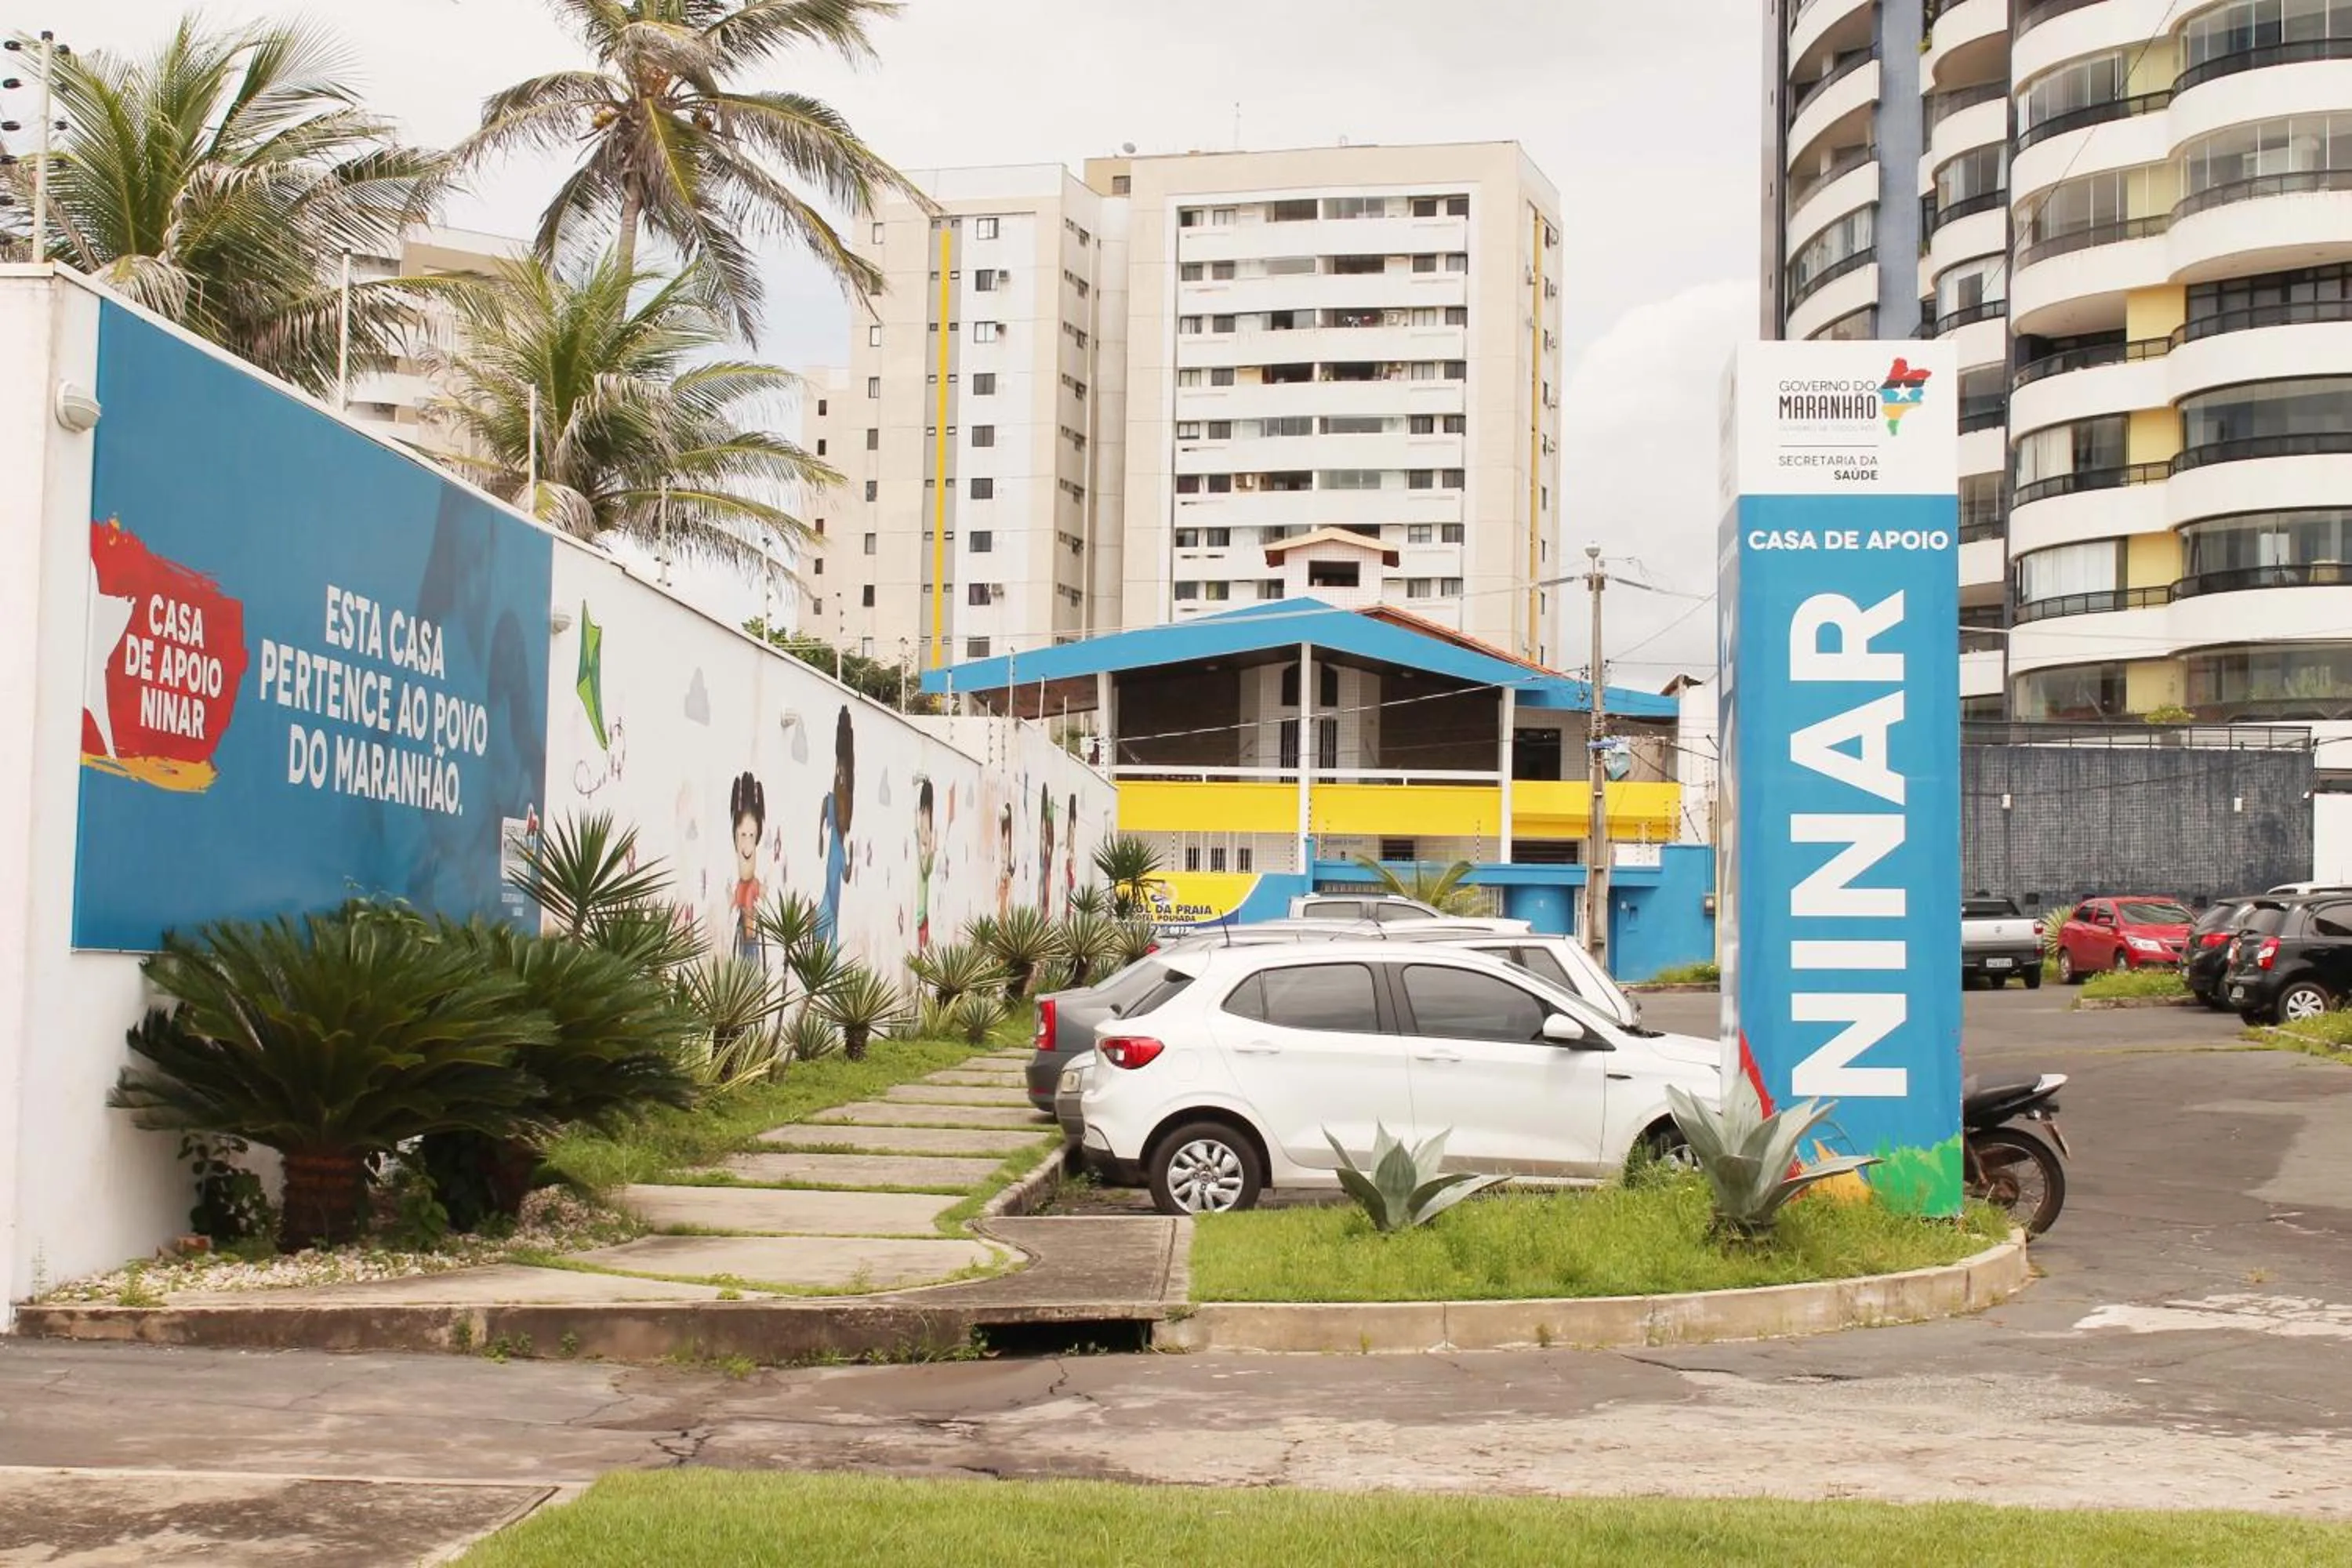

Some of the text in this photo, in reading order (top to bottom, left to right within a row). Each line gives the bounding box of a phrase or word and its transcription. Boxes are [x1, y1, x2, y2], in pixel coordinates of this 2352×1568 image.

[1779, 380, 1877, 391] GOVERNO DO
[1779, 393, 1876, 419] MARANHÃO
[1779, 456, 1878, 466] SECRETARIA DA
[1834, 467, 1878, 481] SAÚDE
[1748, 530, 1949, 550] CASA DE APOIO
[149, 593, 204, 649] CASA
[325, 584, 445, 680] ESTA CASA
[125, 633, 223, 699] DE APOIO
[140, 686, 205, 740] NINAR
[260, 638, 488, 757] PERTENCE AO POVO
[288, 724, 463, 816] DO MARANHÃO.
[1789, 589, 1907, 1097] NINAR
[1131, 904, 1213, 915] OL DA PRAIA
